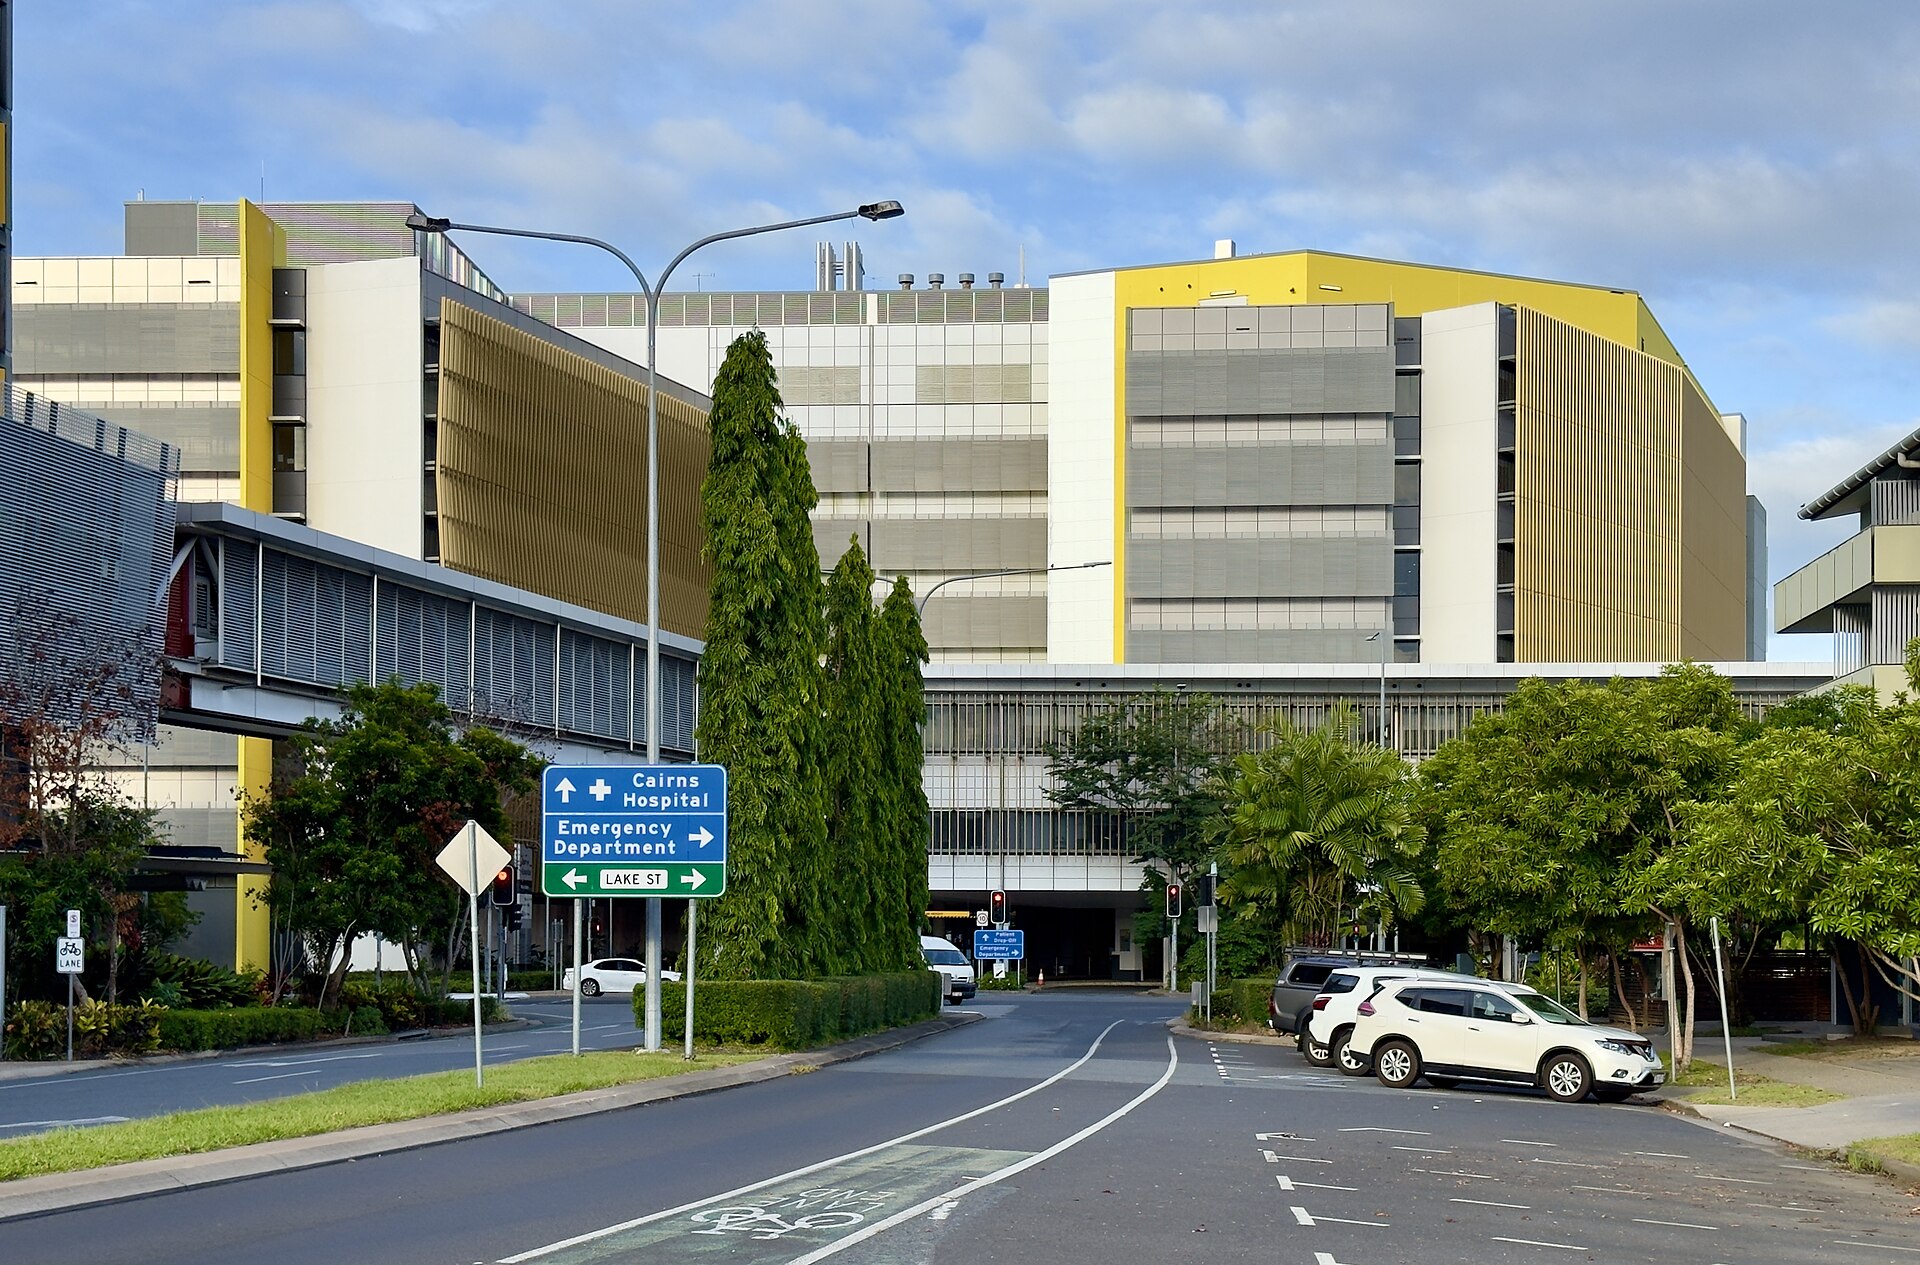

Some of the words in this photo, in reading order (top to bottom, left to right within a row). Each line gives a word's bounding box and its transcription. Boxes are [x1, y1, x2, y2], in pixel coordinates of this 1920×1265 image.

[632, 772, 700, 788] Cairns
[623, 792, 709, 811] Hospital
[558, 820, 672, 838] Emergency
[554, 839, 676, 858] Department
[606, 873, 640, 885] LAKE
[646, 873, 662, 885] ST
[59, 959, 81, 968] LANE
